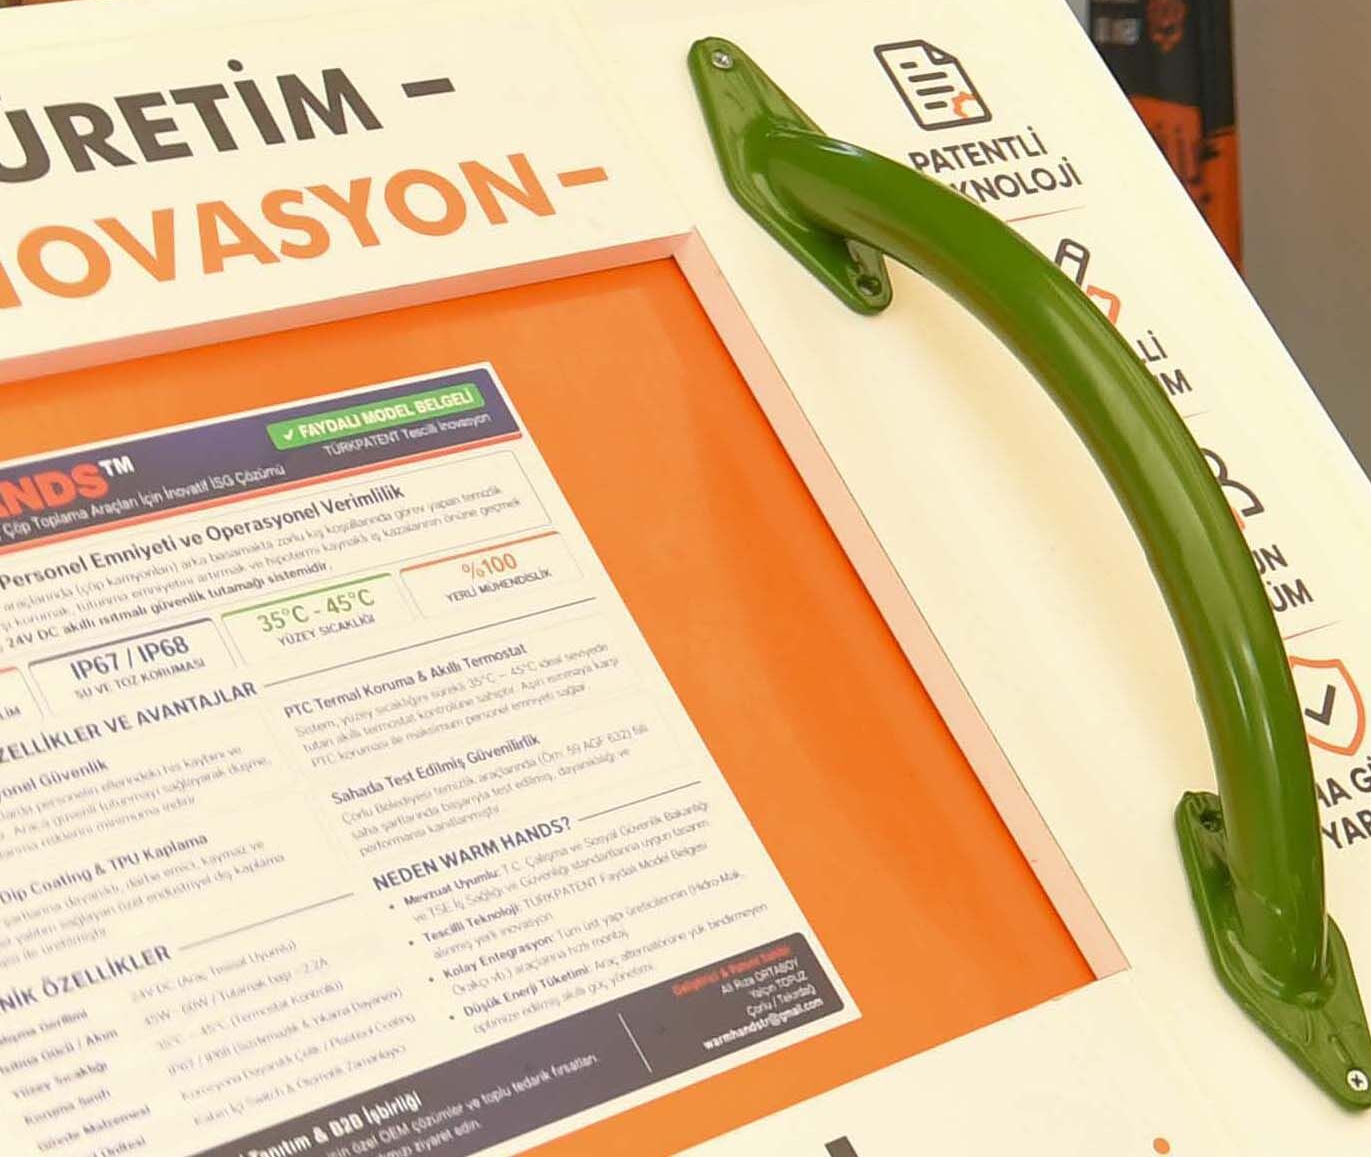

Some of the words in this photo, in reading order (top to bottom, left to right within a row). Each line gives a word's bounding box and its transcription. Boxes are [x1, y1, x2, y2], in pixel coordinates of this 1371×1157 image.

[908, 125, 1048, 174] PATENTLİ
[294, 411, 366, 442] FAYDALI
[357, 400, 418, 428] MODEL
[410, 387, 478, 417] BELGELİ
[322, 431, 400, 455] TÜRKPATENT
[2, 522, 31, 539] Çöp
[31, 509, 88, 529] Toplama
[138, 492, 163, 507] İçin
[163, 479, 209, 499] İnovatif
[0, 556, 88, 590] Personel
[90, 535, 177, 568] Emniyeti
[179, 534, 202, 547] ve
[206, 502, 320, 541] Operasyonel
[320, 484, 404, 514] Verimlilik
[446, 586, 477, 602] YERLİ
[478, 569, 552, 593] MÜHENDİSLİK
[462, 553, 517, 579] %100
[37, 627, 59, 640] DC
[151, 591, 206, 614] güvenlik
[257, 605, 309, 632] 35°C
[327, 589, 374, 613] 45°C
[278, 630, 315, 646] YÜZEY
[319, 614, 375, 635] SICAKLIĞI
[70, 652, 118, 680] IP67
[137, 636, 189, 663] IP68
[114, 675, 138, 689] TOZ
[140, 658, 205, 683] KORUMASI
[284, 701, 313, 718] PTC
[313, 687, 361, 710] Termal
[362, 676, 415, 697] Koruma
[462, 644, 527, 668] Termostat
[104, 716, 132, 732] VE
[137, 682, 257, 726] AVANTAJLAR
[39, 759, 108, 786] Güvenlik
[332, 781, 384, 804] Sahada
[384, 771, 415, 787] Test
[416, 758, 465, 779] Edilmiş
[467, 734, 540, 764] Güvenilirlik
[30, 870, 92, 894] Coating
[110, 852, 140, 870] TPU
[142, 836, 208, 860] Kaplama
[373, 859, 439, 891] NEDEN
[439, 840, 500, 868] WARM
[500, 816, 570, 850] HANDS?
[404, 884, 452, 905] Mevzuat
[423, 921, 465, 942] Tescilli
[43, 946, 171, 997] ÖZELLİKLER
[443, 962, 477, 978] Kolay
[775, 970, 808, 988] TOPUZ
[463, 996, 502, 1016] Düşük
[503, 983, 538, 1002] Enerji
[359, 1086, 427, 1130] İşbirliği
[379, 1122, 409, 1142] OEM
